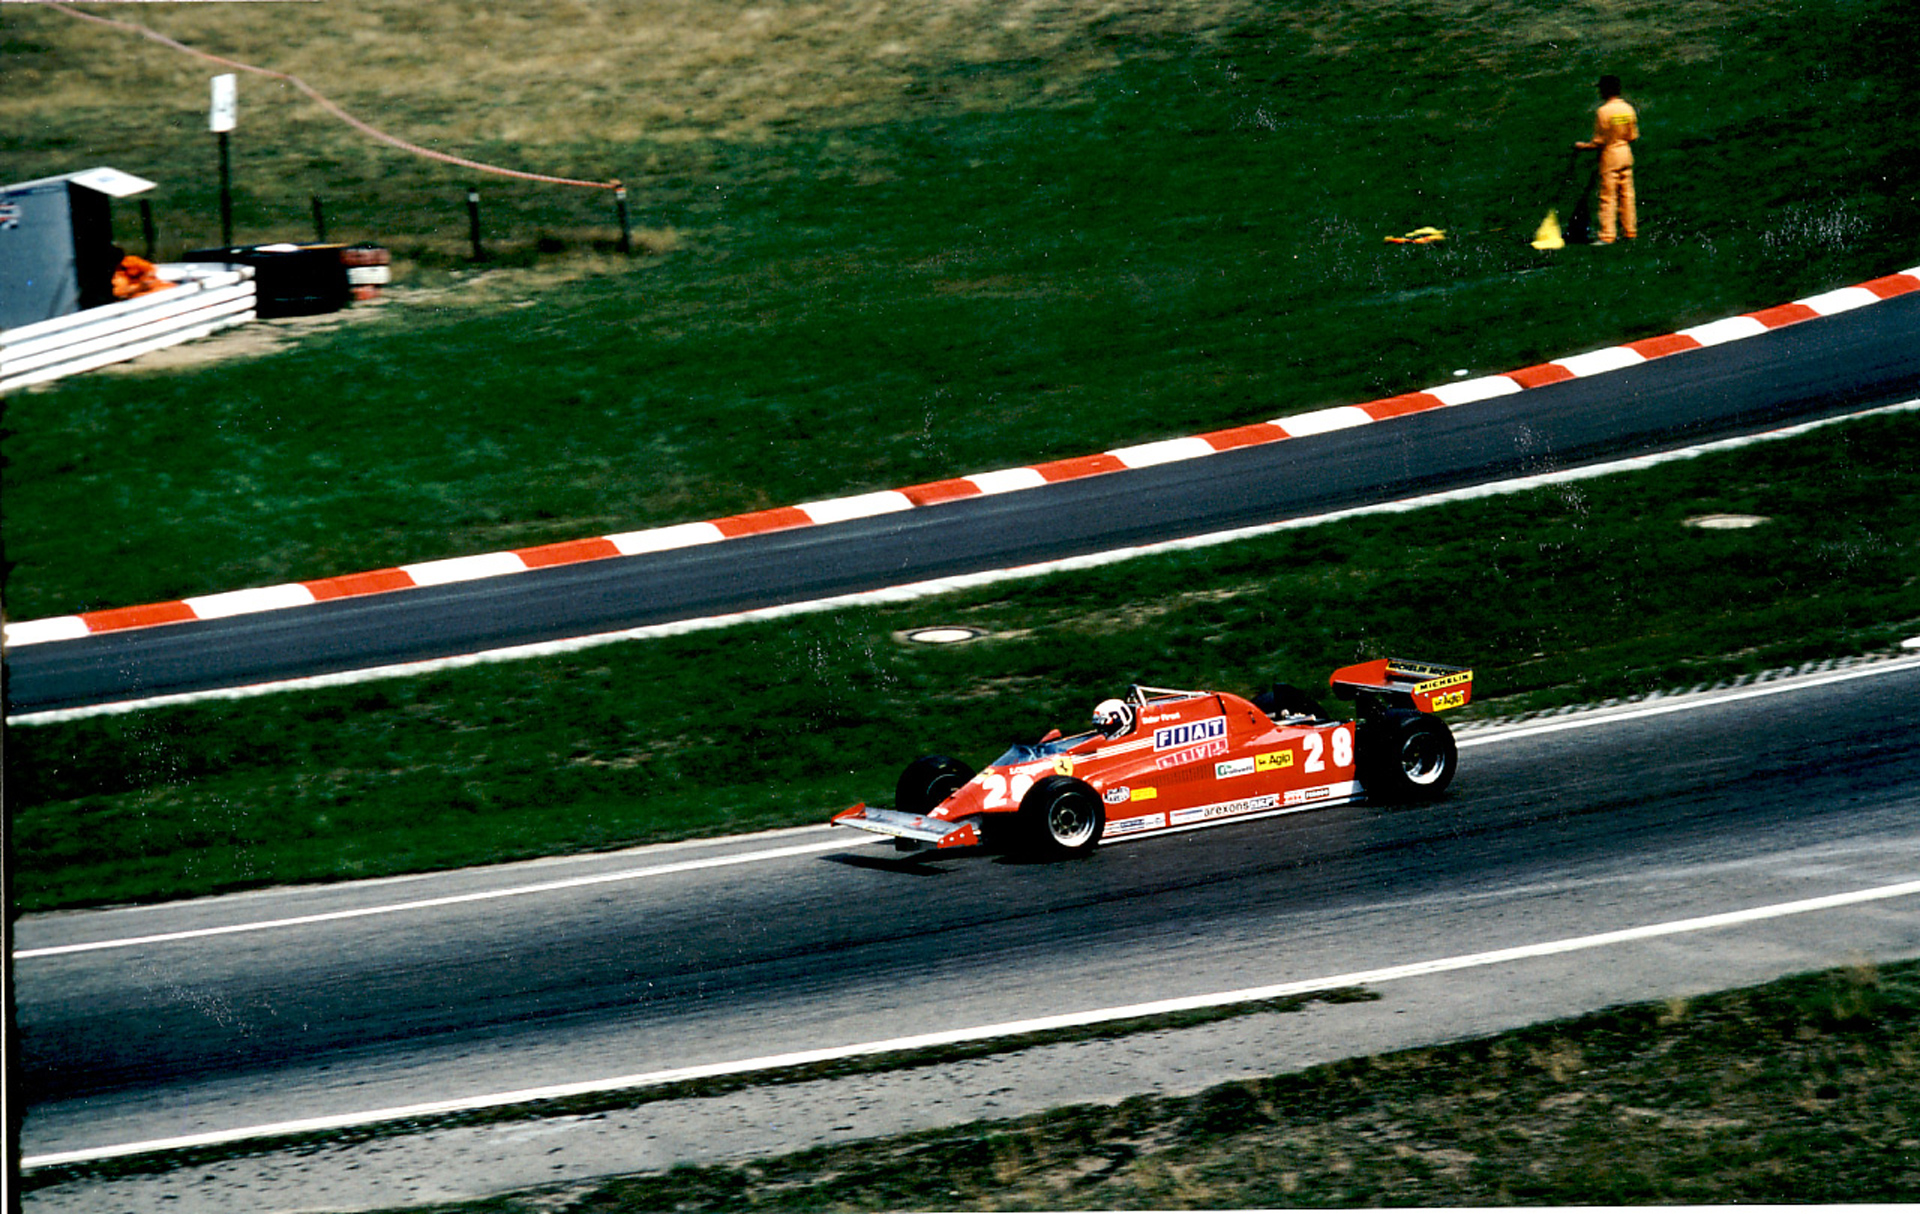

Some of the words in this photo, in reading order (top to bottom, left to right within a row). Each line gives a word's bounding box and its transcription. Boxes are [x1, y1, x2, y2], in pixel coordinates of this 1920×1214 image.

[1420, 674, 1469, 690] MICHELIN
[1156, 718, 1224, 748] FIAT
[1303, 727, 1353, 773] 28
[1269, 754, 1291, 766] Agip
[1203, 801, 1250, 817] arexons
